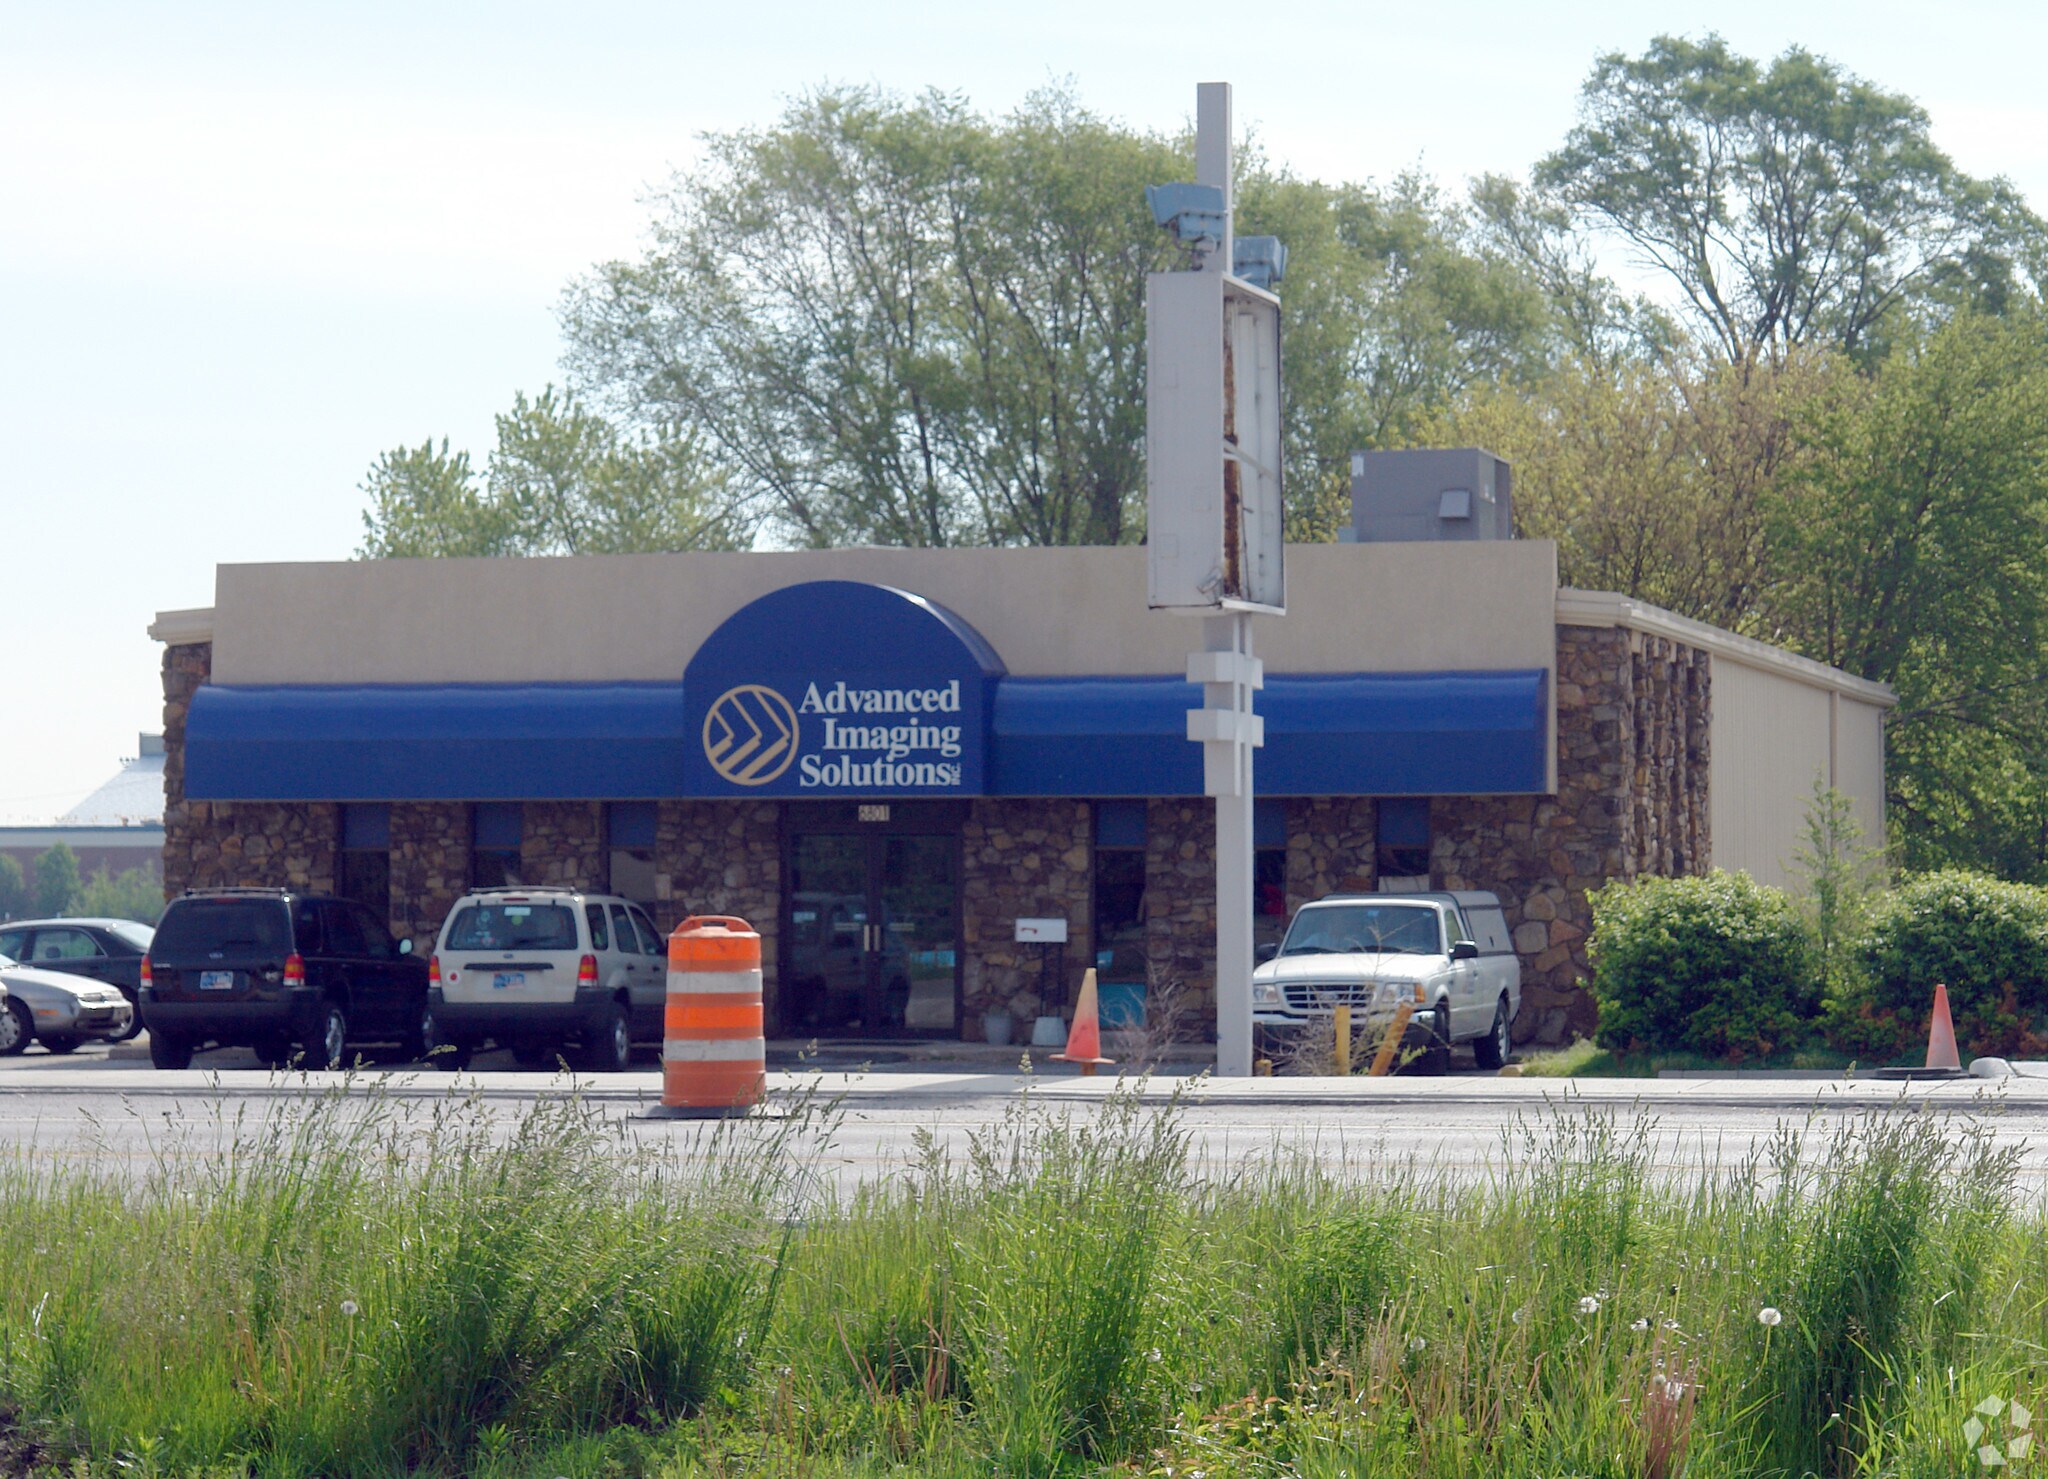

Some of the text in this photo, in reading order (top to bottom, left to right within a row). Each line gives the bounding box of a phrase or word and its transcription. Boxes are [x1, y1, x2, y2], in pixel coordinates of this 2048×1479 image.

[798, 680, 961, 713] Advanced
[822, 717, 962, 758] Imaging
[800, 753, 951, 787] Solutions
